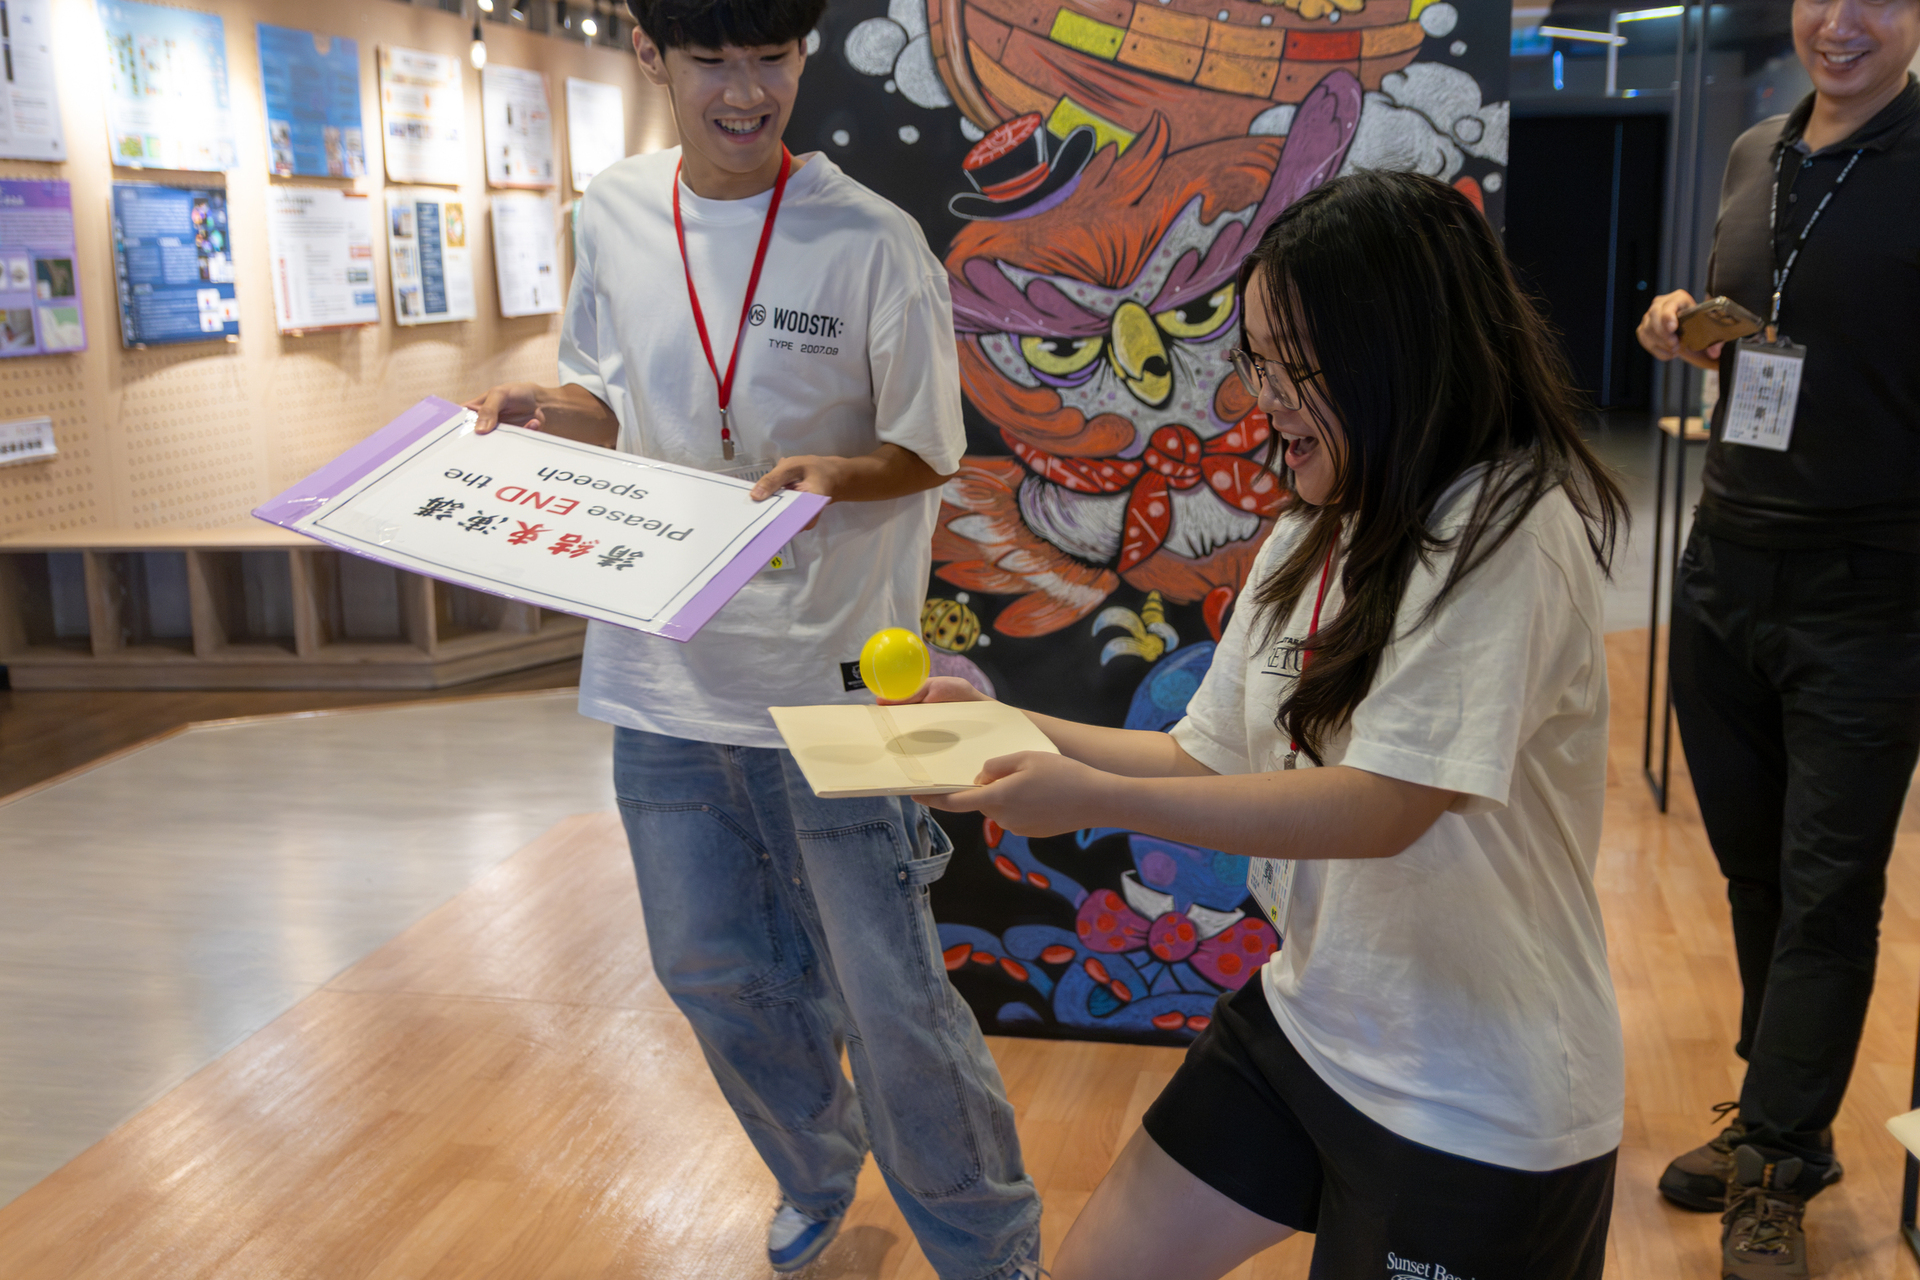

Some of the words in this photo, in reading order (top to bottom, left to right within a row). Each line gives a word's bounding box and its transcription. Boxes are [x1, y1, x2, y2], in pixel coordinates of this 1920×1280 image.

[774, 307, 844, 338] WODSTK:
[769, 338, 794, 351] TYPE
[800, 343, 839, 356] 2007.09
[444, 468, 493, 489] the
[537, 467, 649, 500] speech
[495, 486, 580, 515] END
[414, 497, 644, 570] 請結束演講
[587, 505, 694, 541] Please
[1387, 1251, 1431, 1277] Sunset
